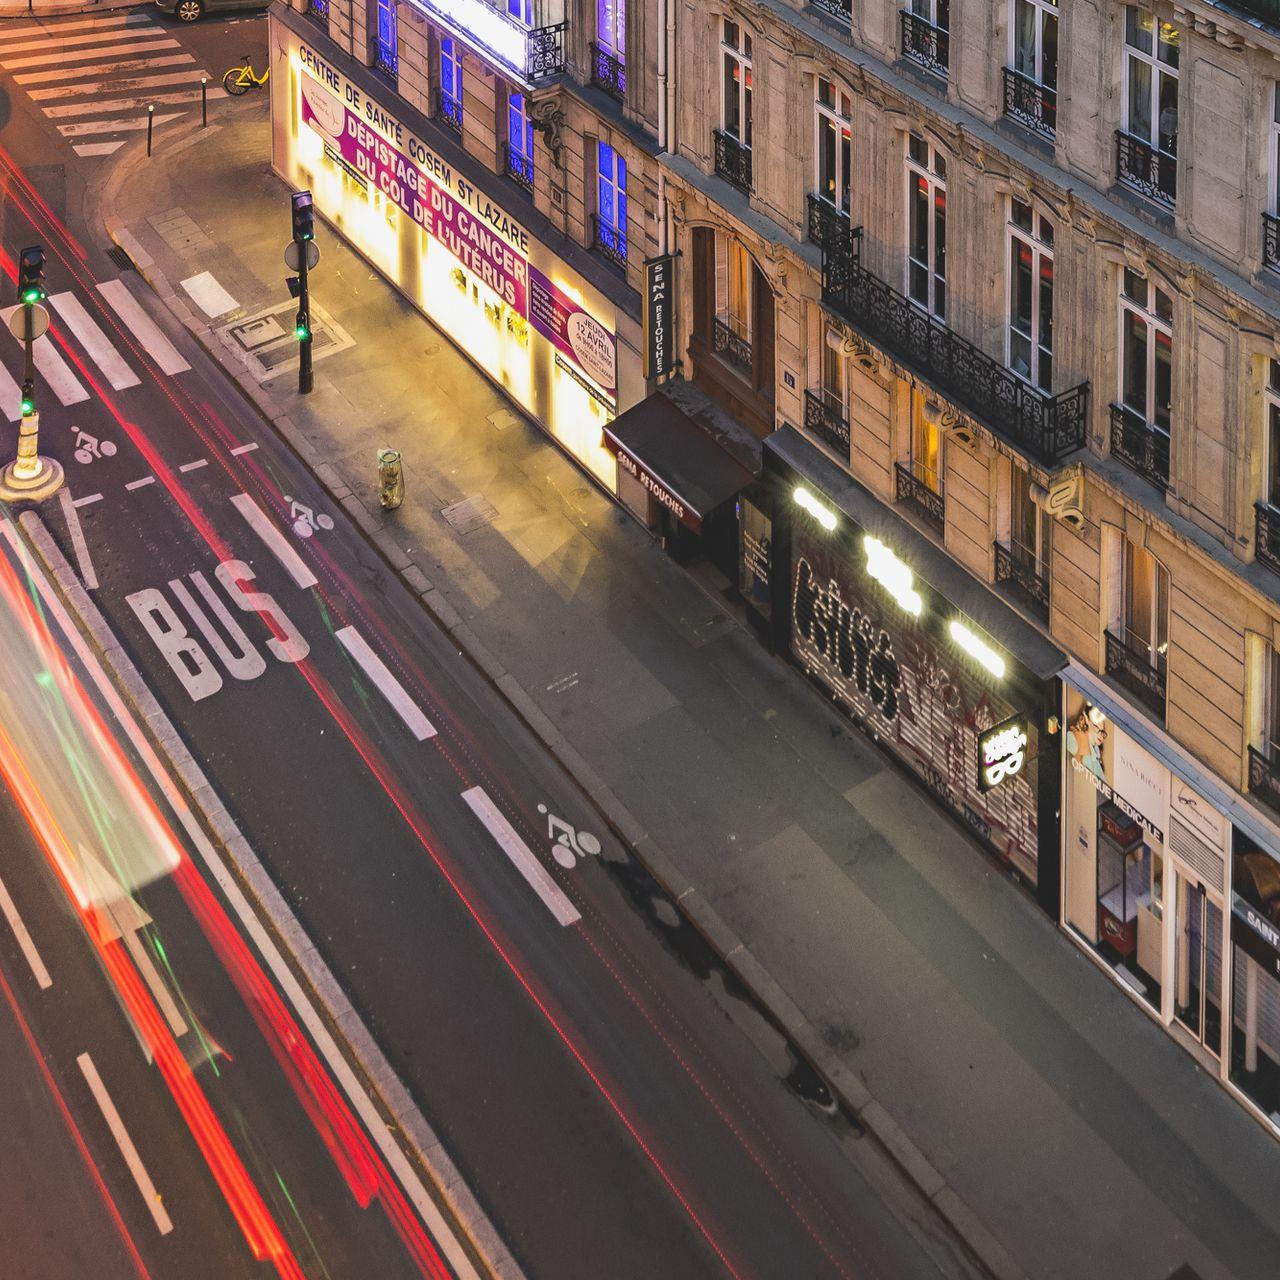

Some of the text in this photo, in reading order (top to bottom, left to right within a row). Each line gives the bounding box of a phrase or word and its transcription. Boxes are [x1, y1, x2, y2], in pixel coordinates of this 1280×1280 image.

[300, 45, 340, 93] CENTRE
[345, 84, 360, 110] DE
[365, 100, 403, 146] SANTÉ
[408, 138, 451, 188] COSEM
[458, 179, 473, 205] ST
[477, 194, 529, 254] LAZARE
[348, 115, 427, 200] DÉPISTAGE
[431, 183, 453, 221] DU
[457, 211, 526, 288] CANCER
[356, 149, 376, 181] DU
[380, 171, 409, 212] COL
[413, 198, 433, 235] DE
[437, 219, 516, 306] L'UTÉRUS
[576, 321, 612, 359] 12 AVRIL
[584, 319, 606, 340] JEUDI
[653, 264, 665, 373] SENA RETOUCHES
[617, 450, 684, 518] SENA RETOUCHES
[124, 558, 311, 702] BUS
[1071, 758, 1113, 800] OPTIQUE
[1113, 792, 1161, 841] MEDICALE
[1247, 910, 1280, 946] SAINT
